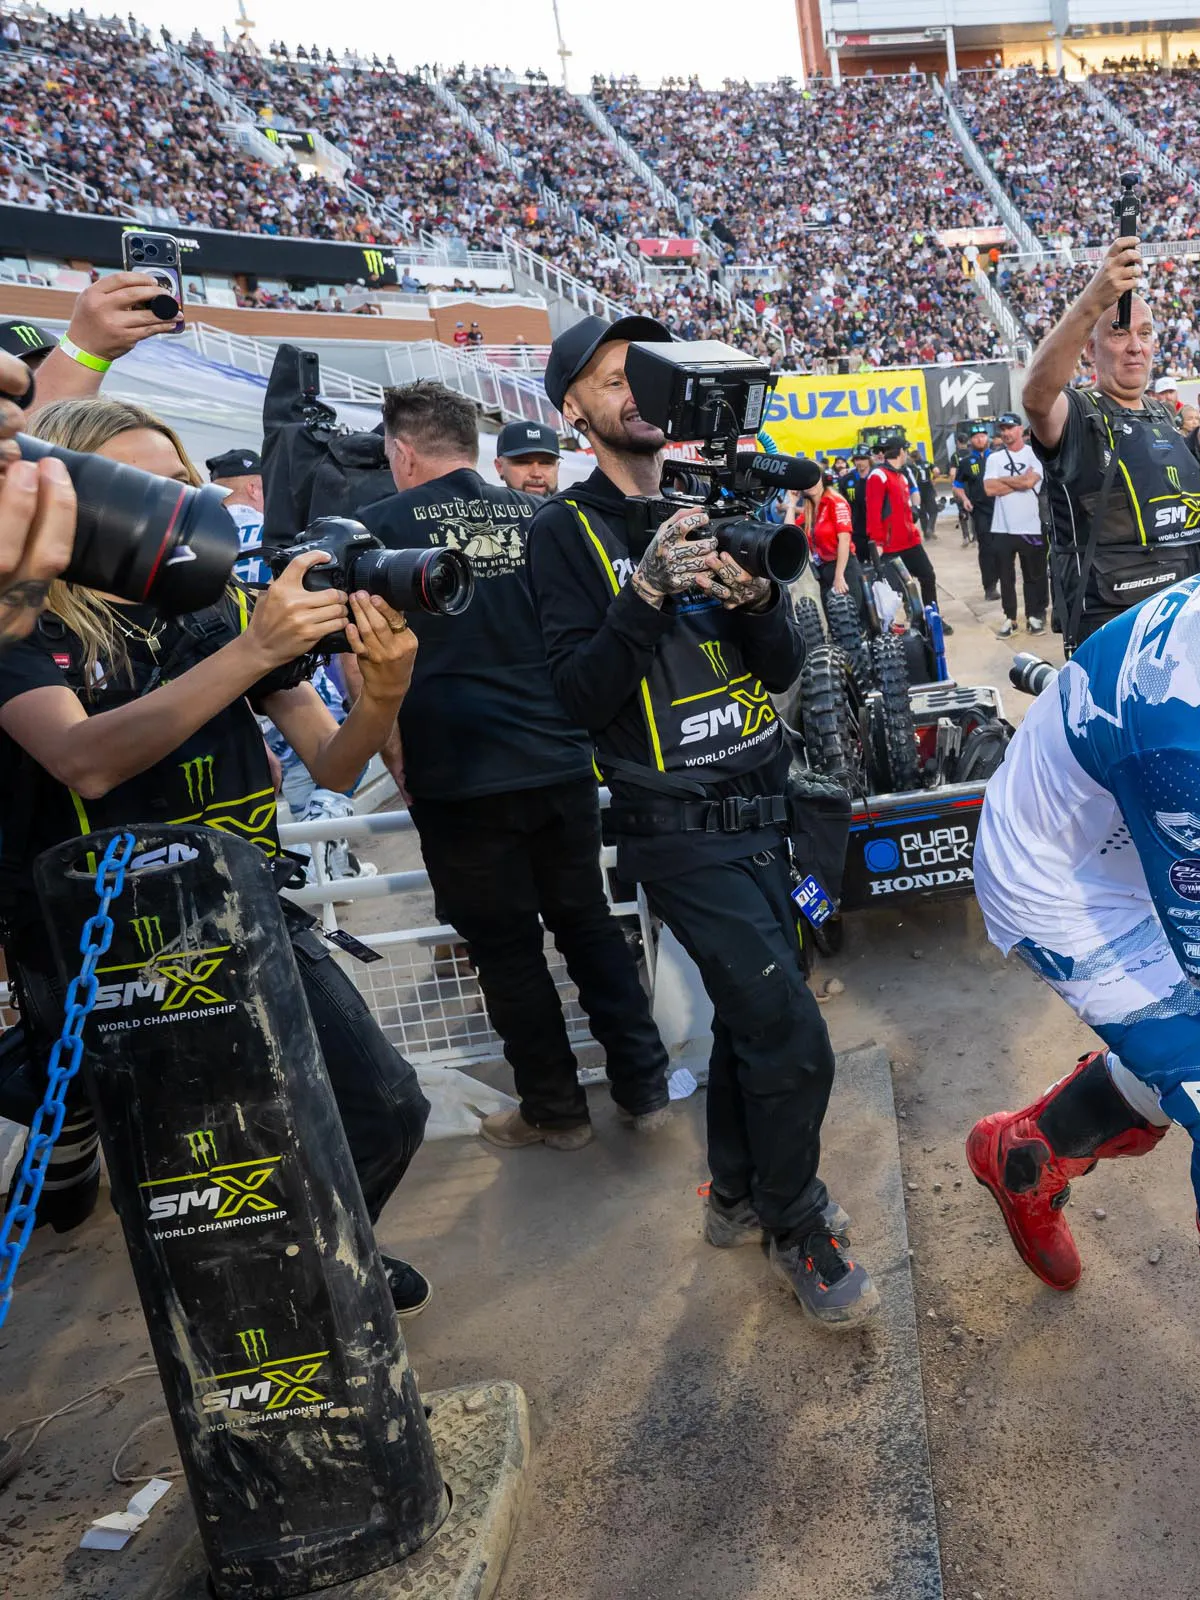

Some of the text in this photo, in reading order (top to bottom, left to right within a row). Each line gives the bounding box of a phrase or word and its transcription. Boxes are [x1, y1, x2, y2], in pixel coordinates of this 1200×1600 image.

[658, 241, 669, 254] 7
[765, 385, 920, 422] SUZUKI
[752, 455, 789, 476] RØDE
[353, 533, 371, 541] Canon
[1158, 531, 1180, 542] WORLD
[680, 680, 776, 746] SMX
[685, 720, 780, 768] WORLD CHAMPIONSHIP
[900, 825, 969, 851] QUAD
[903, 843, 972, 869] LOCK
[869, 866, 974, 896] HONDA
[93, 958, 227, 1012] SMX
[98, 1004, 236, 1033] WORLD CHAMPIONSHIP
[147, 1167, 279, 1221] SMX
[153, 1210, 287, 1241] WORLD CHAMPIONSHIP
[201, 1362, 326, 1415] SMX
[208, 1401, 335, 1433] WORLD CHAMPIONSHIP
